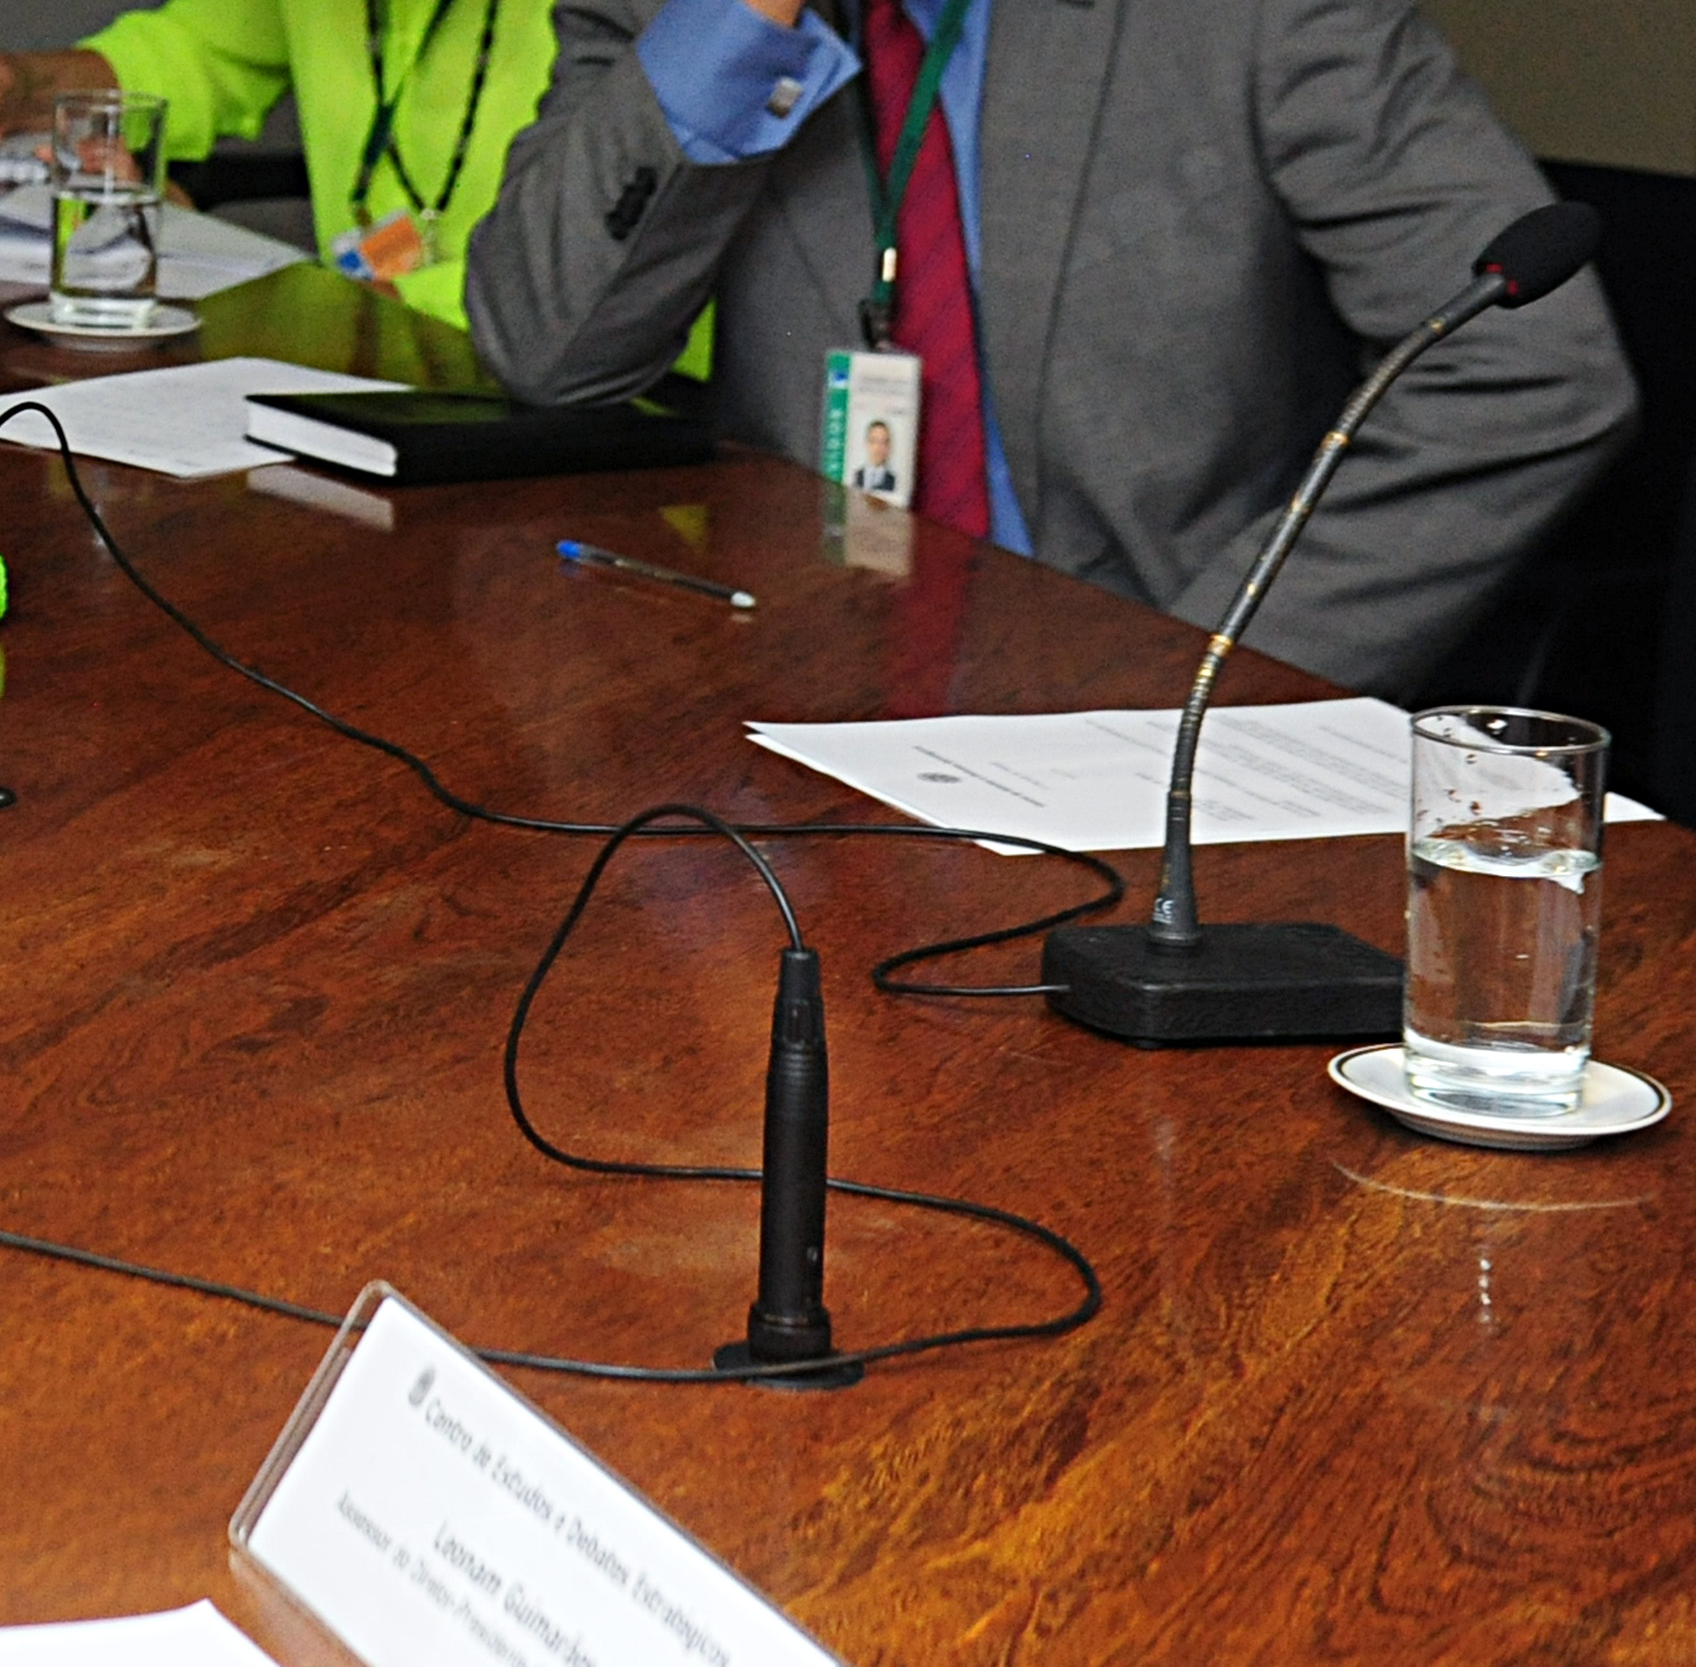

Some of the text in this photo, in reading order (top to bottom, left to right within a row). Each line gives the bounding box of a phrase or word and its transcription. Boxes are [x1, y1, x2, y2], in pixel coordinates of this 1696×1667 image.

[425, 1397, 473, 1453] Centro
[472, 1440, 492, 1470] de
[491, 1455, 553, 1521] Estudos
[553, 1513, 566, 1533] e
[566, 1517, 629, 1586] Debates
[432, 1519, 502, 1595] Leonam
